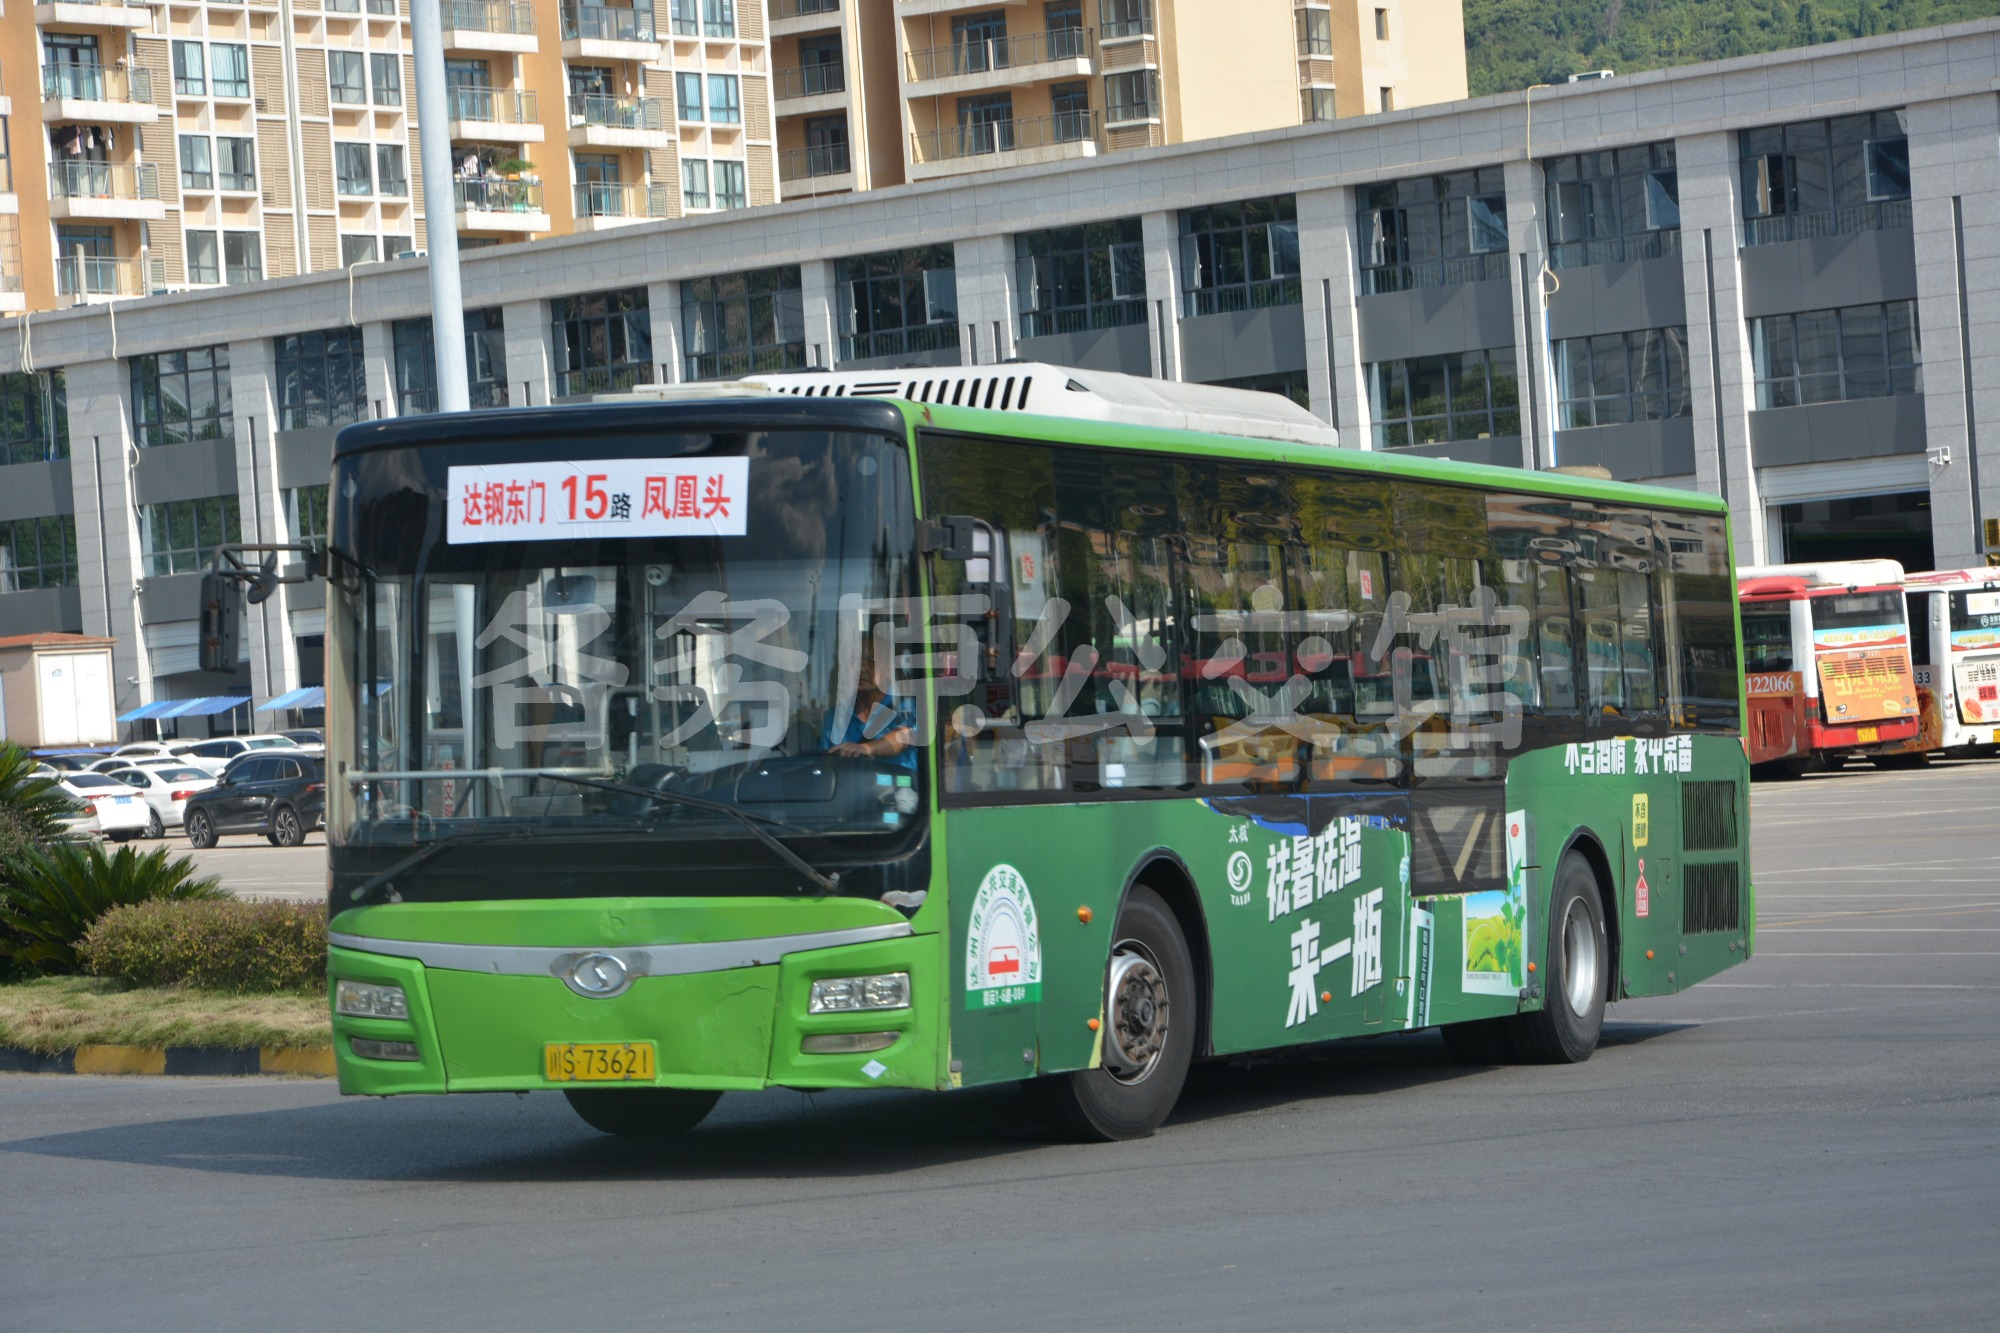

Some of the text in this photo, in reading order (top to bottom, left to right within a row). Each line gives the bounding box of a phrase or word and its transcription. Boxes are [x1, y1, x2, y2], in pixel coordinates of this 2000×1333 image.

[462, 473, 731, 526] 达钢东门 15路 凤凰头
[1746, 674, 1794, 693] 122066
[1914, 672, 1931, 684] 33
[1228, 824, 1249, 843] 太极
[1266, 816, 1362, 922] 祛暑祛湿
[1285, 886, 1384, 1029] 来一瓶
